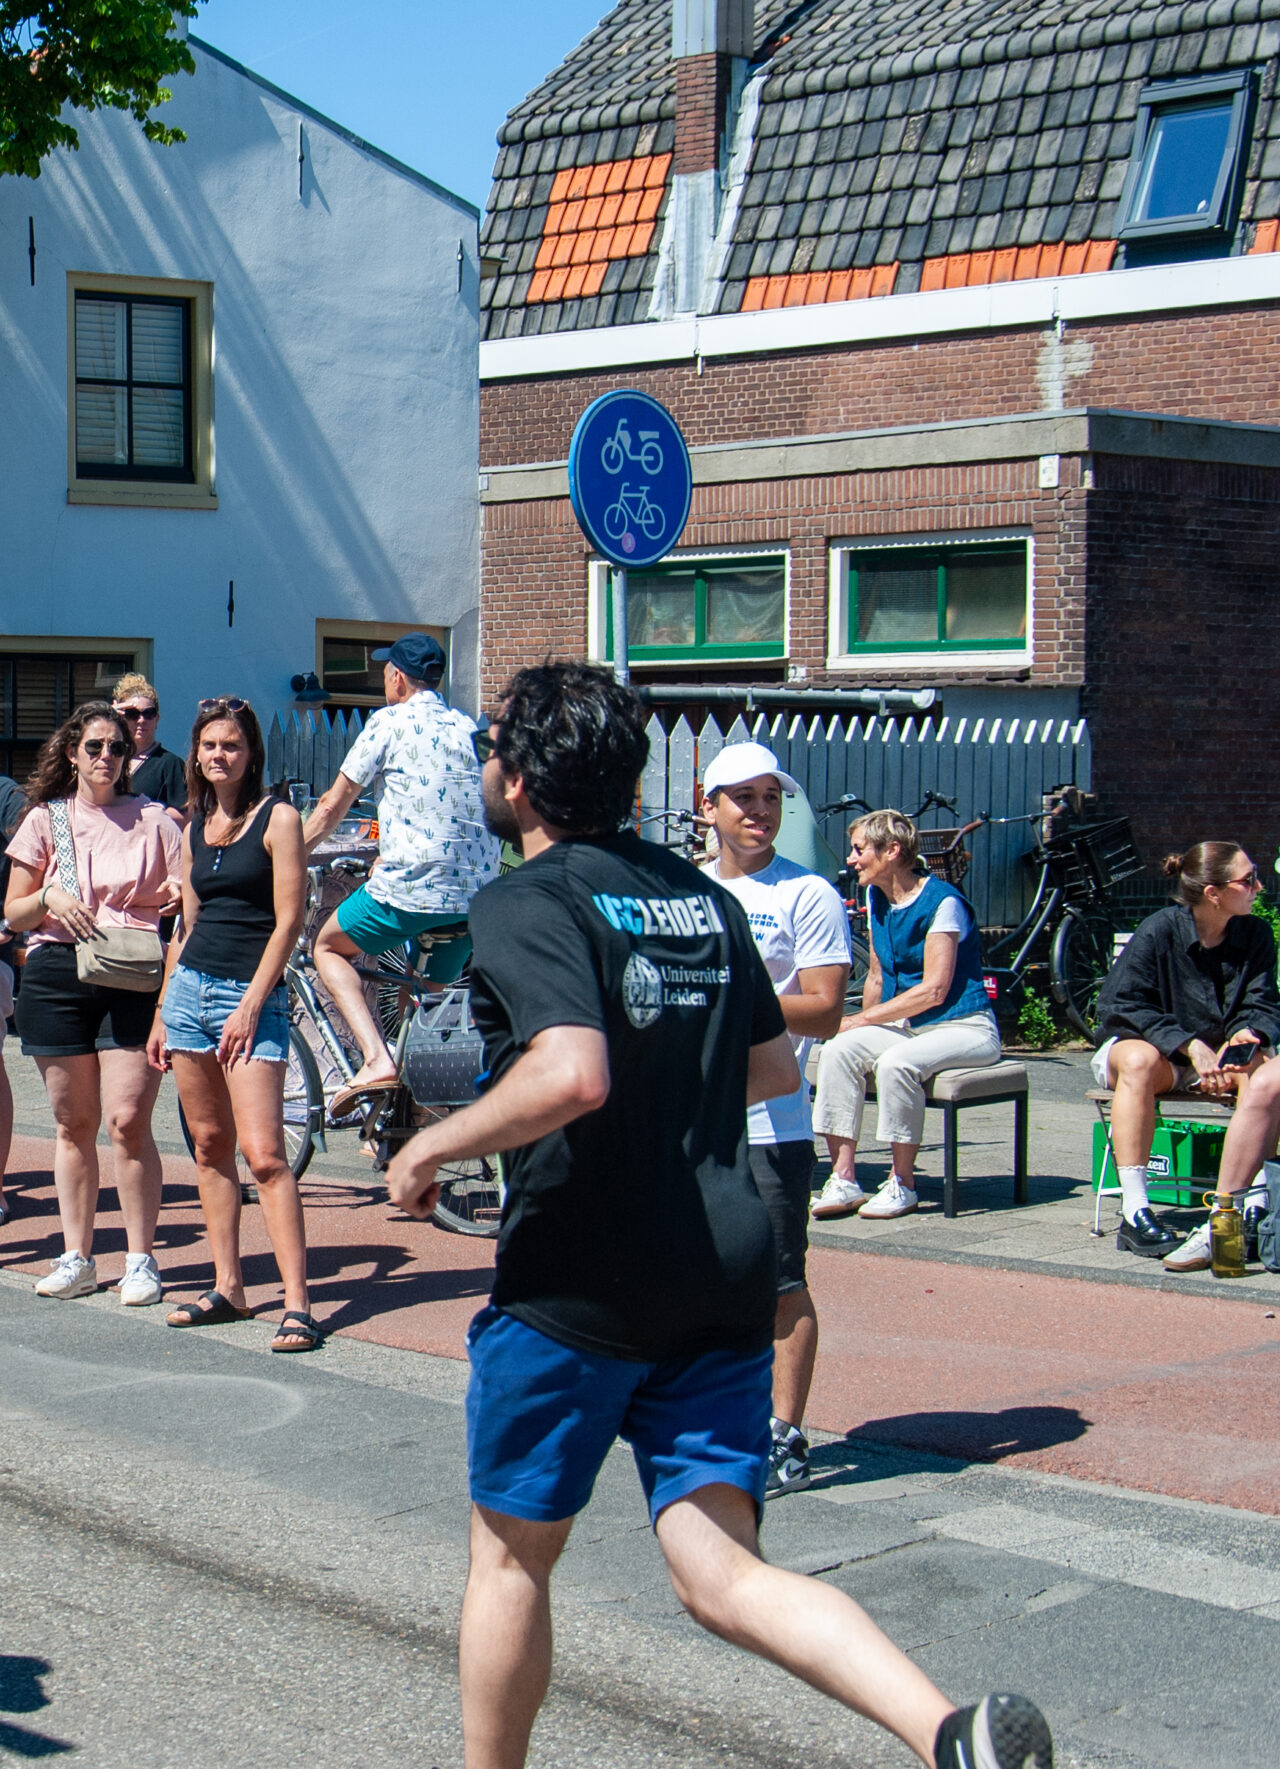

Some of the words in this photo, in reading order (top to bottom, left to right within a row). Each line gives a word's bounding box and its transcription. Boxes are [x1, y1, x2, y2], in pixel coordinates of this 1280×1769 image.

[660, 966, 730, 983] Universitei
[663, 988, 707, 1006] Leiden
[1147, 1160, 1166, 1172] ken
